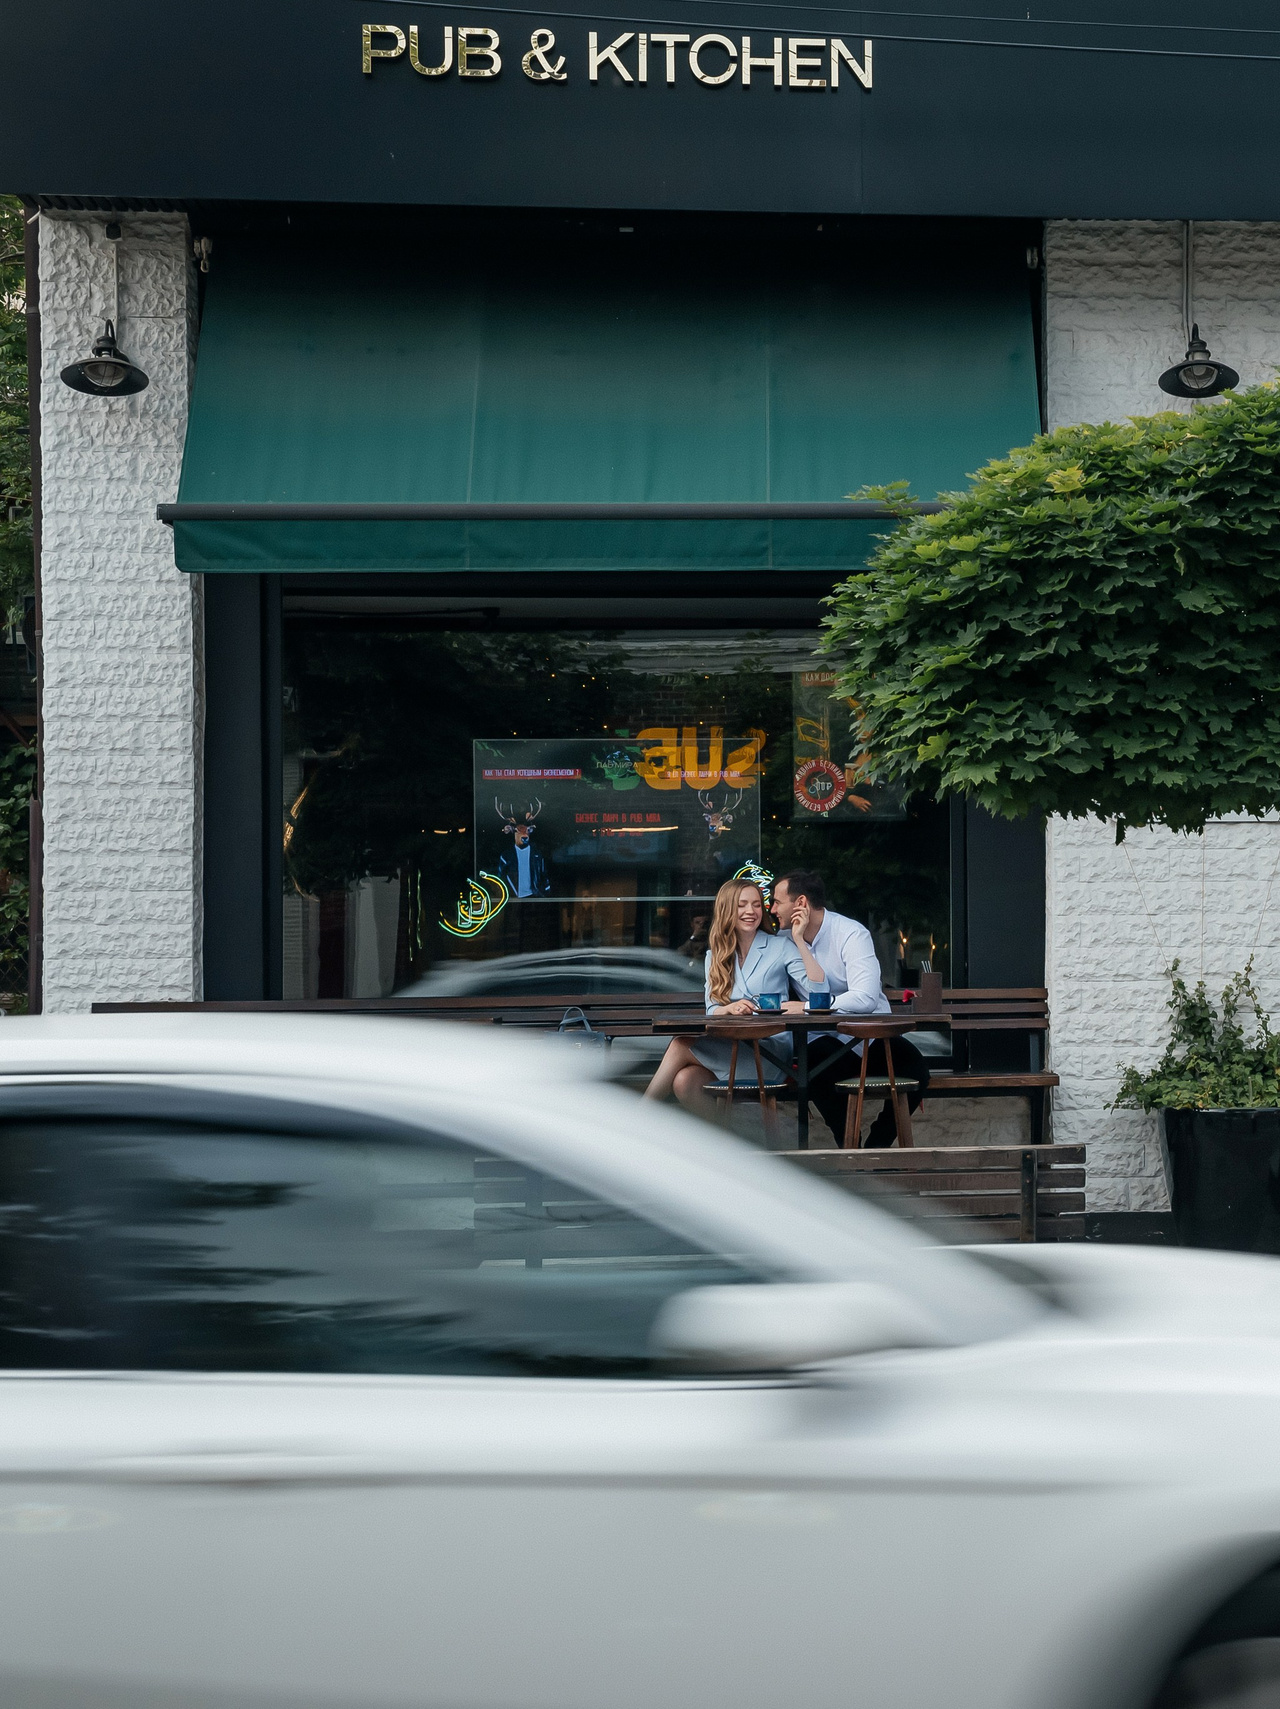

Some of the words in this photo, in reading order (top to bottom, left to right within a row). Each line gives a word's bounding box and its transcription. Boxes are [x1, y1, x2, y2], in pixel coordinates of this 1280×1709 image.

[362, 23, 502, 77] PUB
[520, 27, 568, 82] &
[588, 31, 873, 90] KITCHEN
[484, 769, 493, 777] КАК
[495, 769, 502, 777] ТЫ
[503, 769, 515, 777] СТАЛ
[575, 813, 599, 823] БИЗНЕС
[602, 813, 619, 823] ЛАНЧ
[629, 813, 643, 823] PUB
